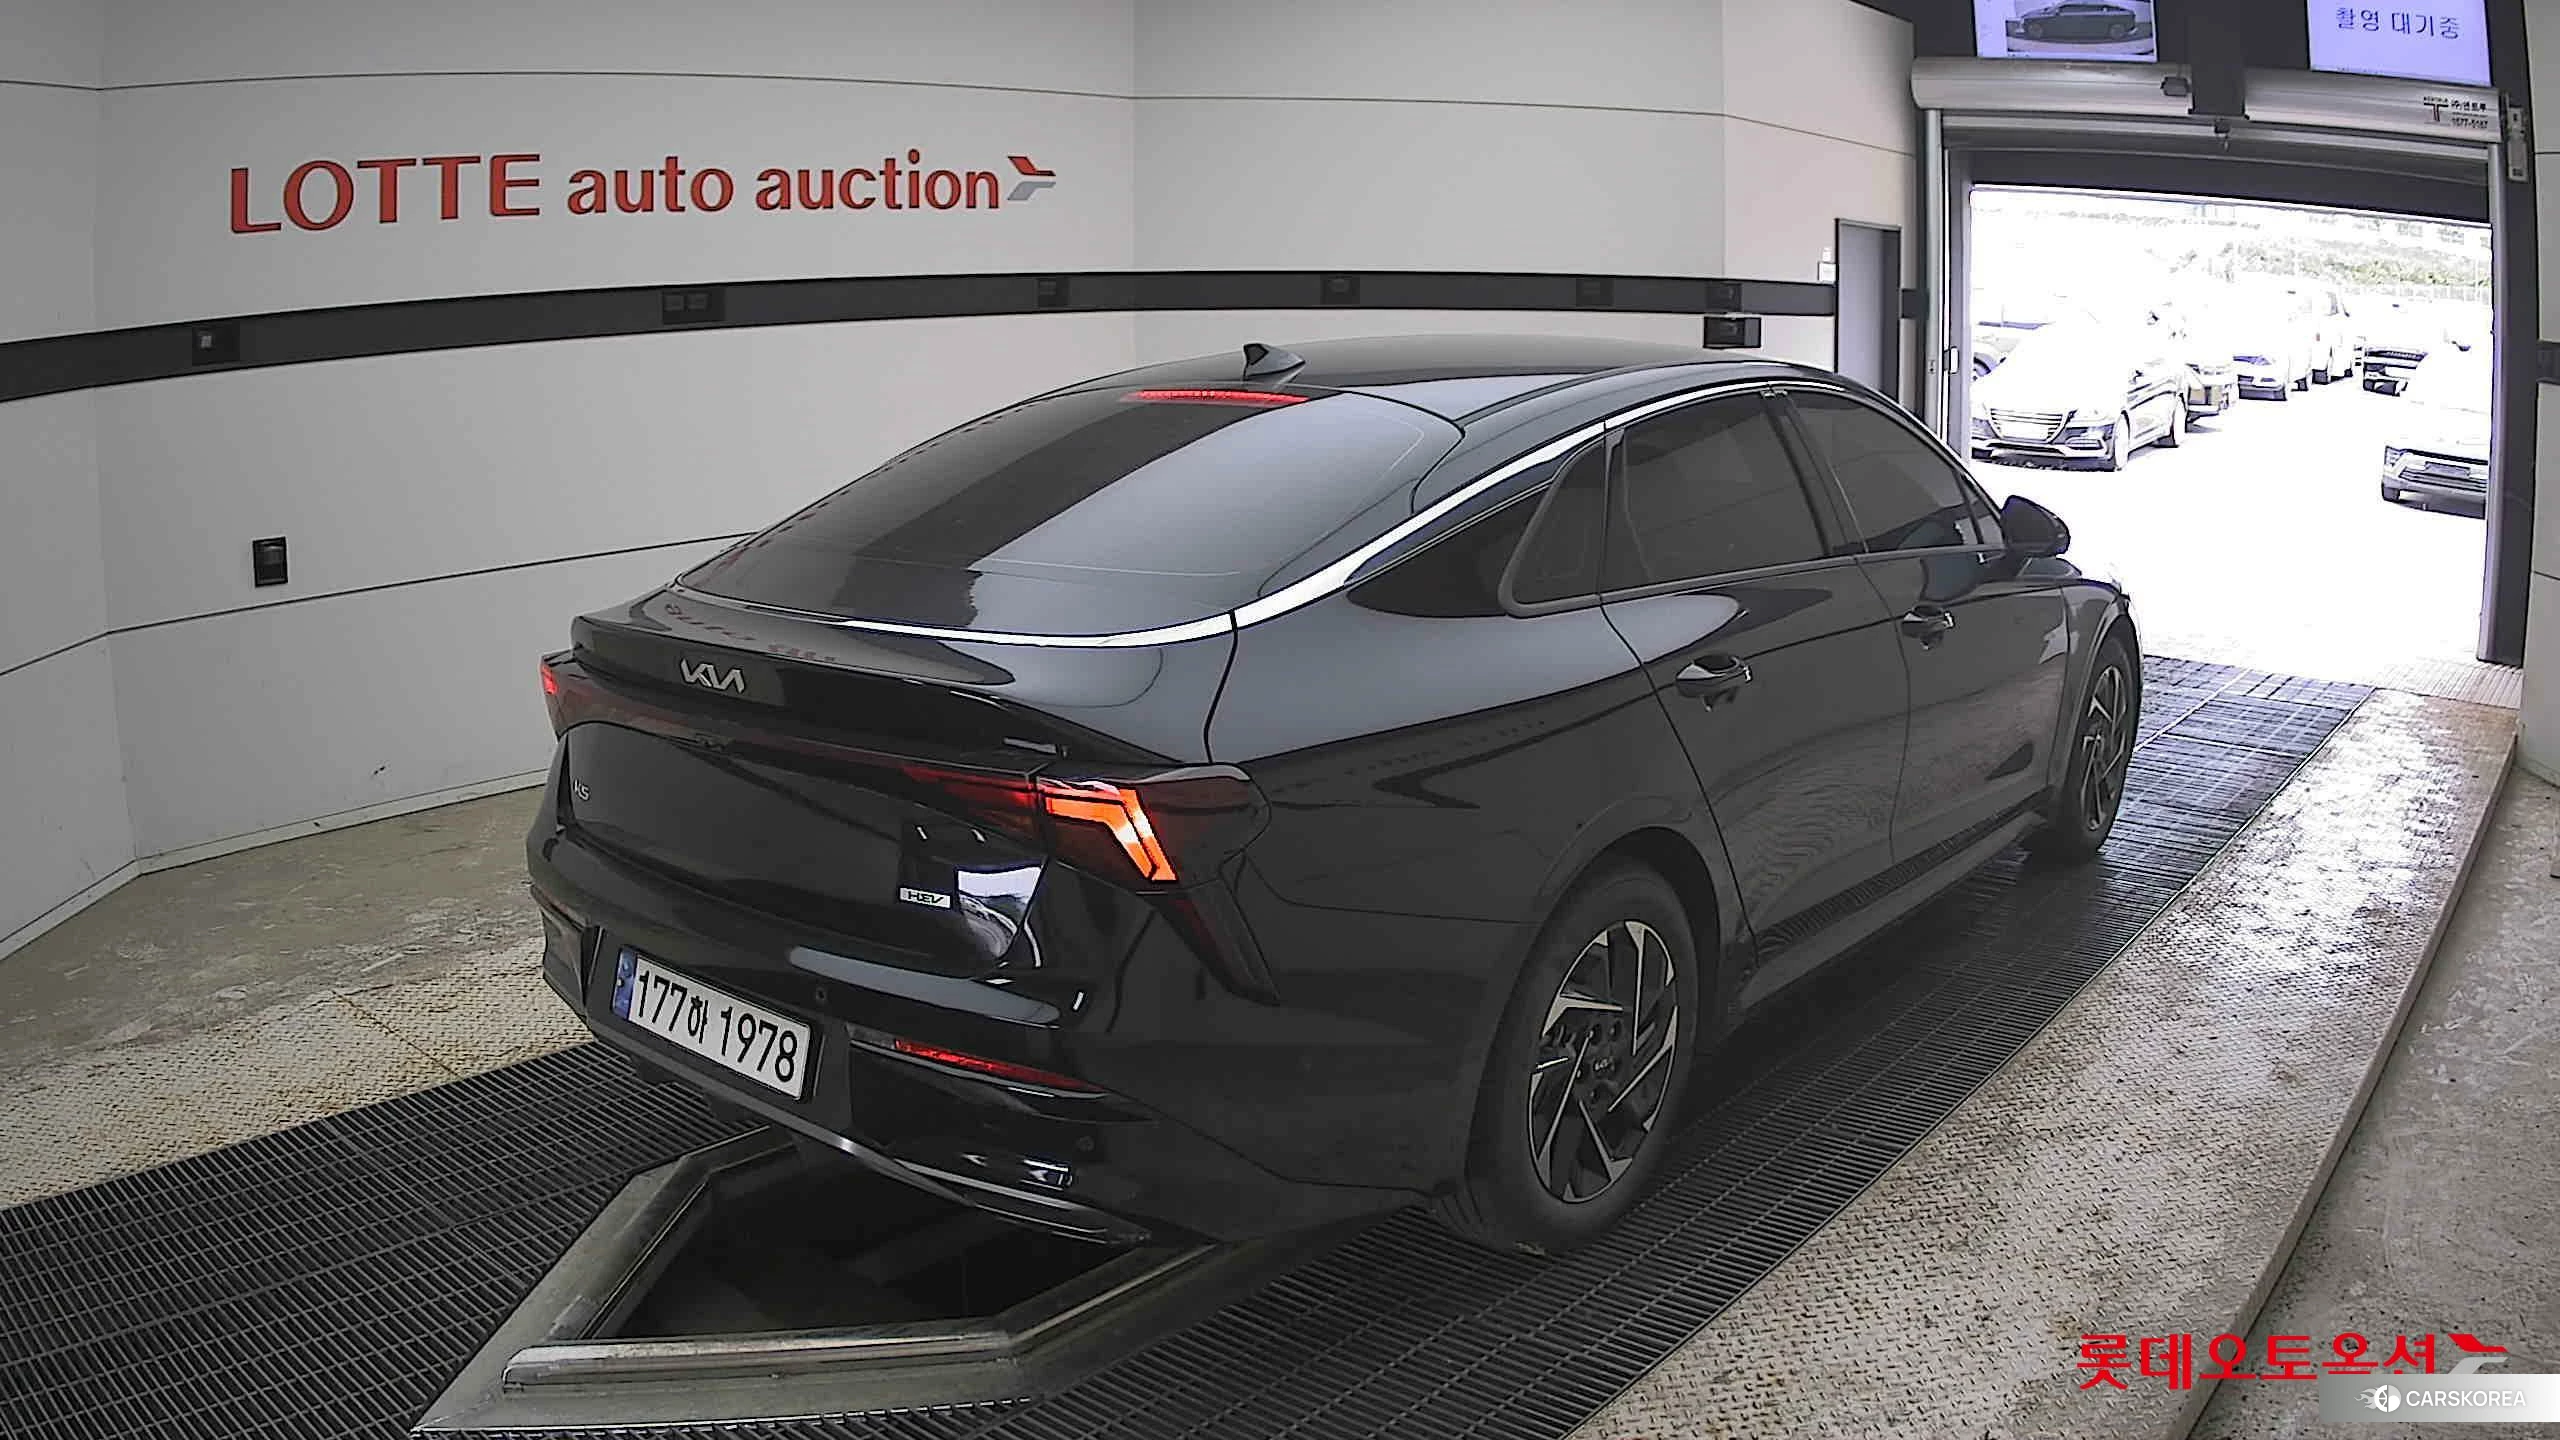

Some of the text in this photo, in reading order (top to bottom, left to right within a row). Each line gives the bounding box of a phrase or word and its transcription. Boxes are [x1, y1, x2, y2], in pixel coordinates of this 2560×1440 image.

[2336, 8, 2460, 39] 촬영 대기중
[230, 149, 1001, 235] LOTTE auto auction
[680, 657, 746, 694] KIA
[574, 779, 589, 801] K5
[908, 890, 944, 903] HEV
[639, 970, 798, 1082] 177하 1978
